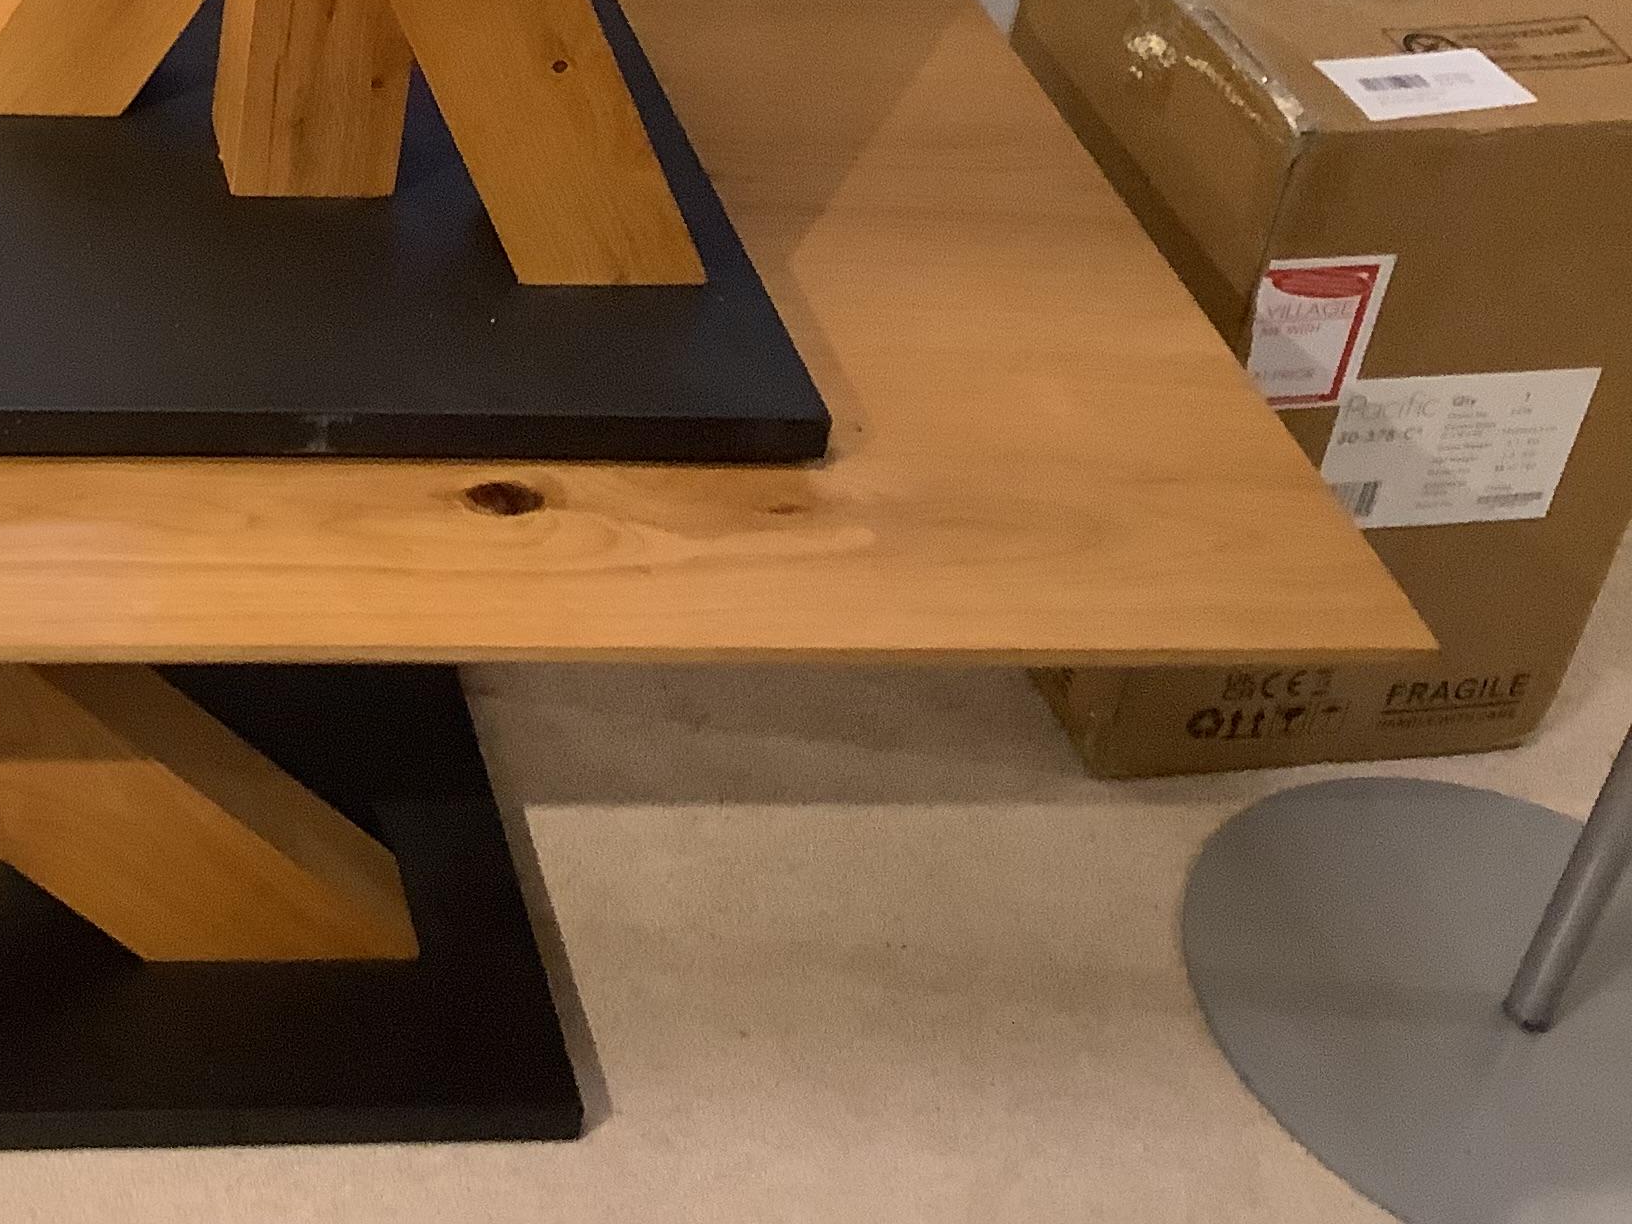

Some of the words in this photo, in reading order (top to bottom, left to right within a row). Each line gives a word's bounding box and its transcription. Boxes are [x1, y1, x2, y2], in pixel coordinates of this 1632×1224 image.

[1266, 301, 1355, 320] VILLAGE
[1343, 391, 1440, 421] Pacific
[1385, 672, 1532, 706] FRAGILE
